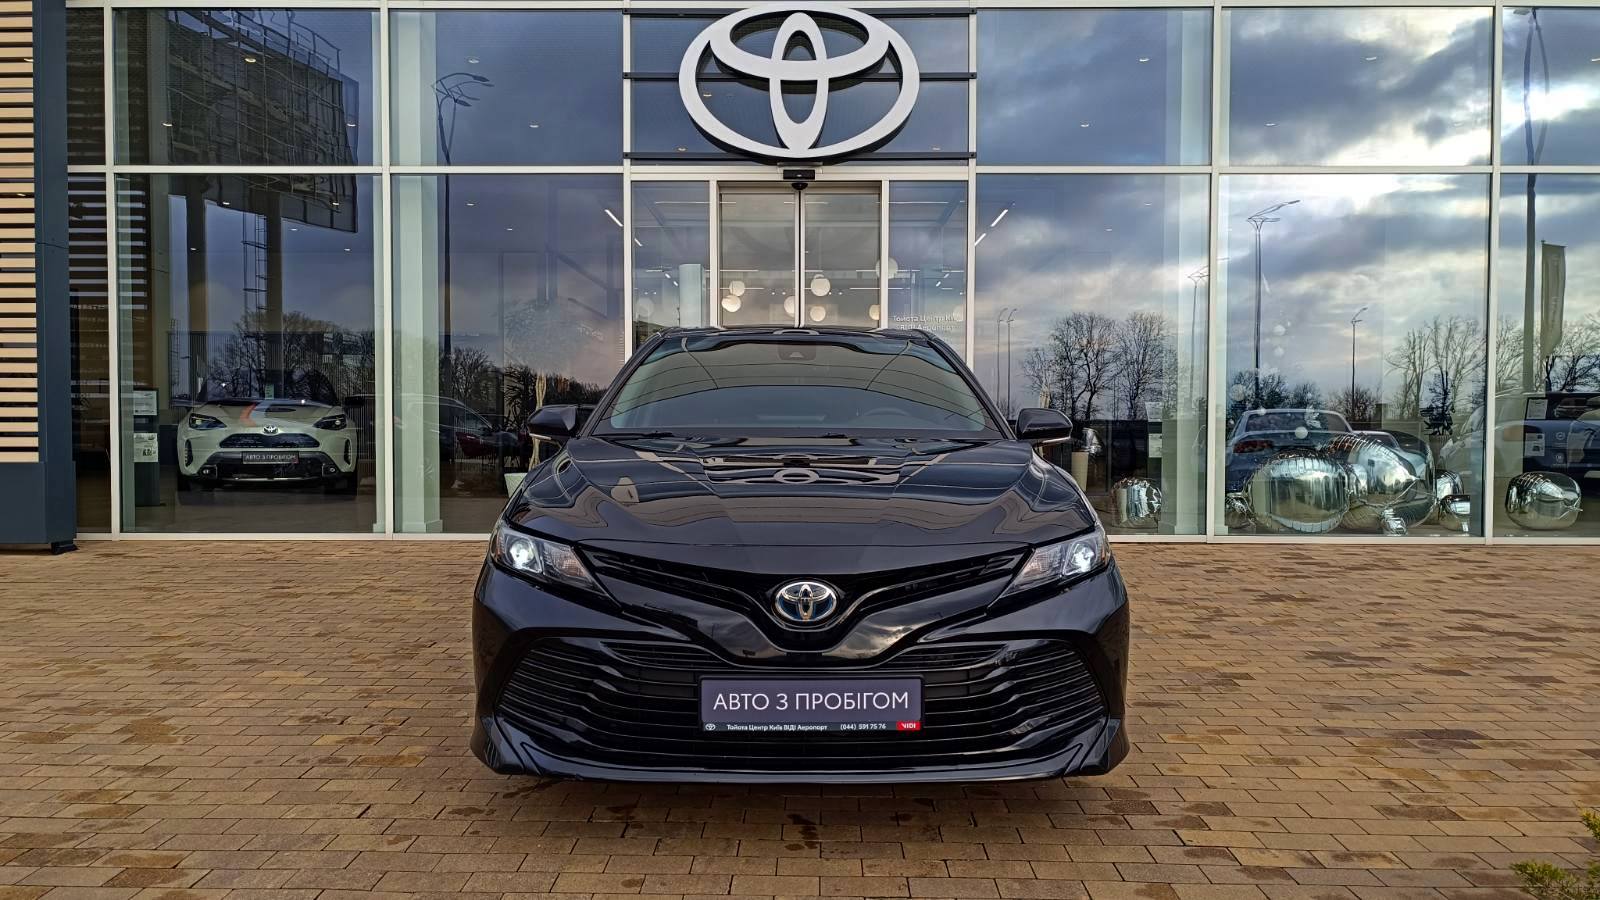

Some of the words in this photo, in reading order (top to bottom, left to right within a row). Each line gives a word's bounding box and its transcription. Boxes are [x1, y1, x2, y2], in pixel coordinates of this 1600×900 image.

[713, 693, 770, 710] АВТО
[776, 693, 788, 710] З
[795, 692, 909, 710] ПРОБІГОМ
[749, 724, 768, 732] Центр
[797, 724, 827, 732] Аеропорт
[840, 723, 857, 731] (044)
